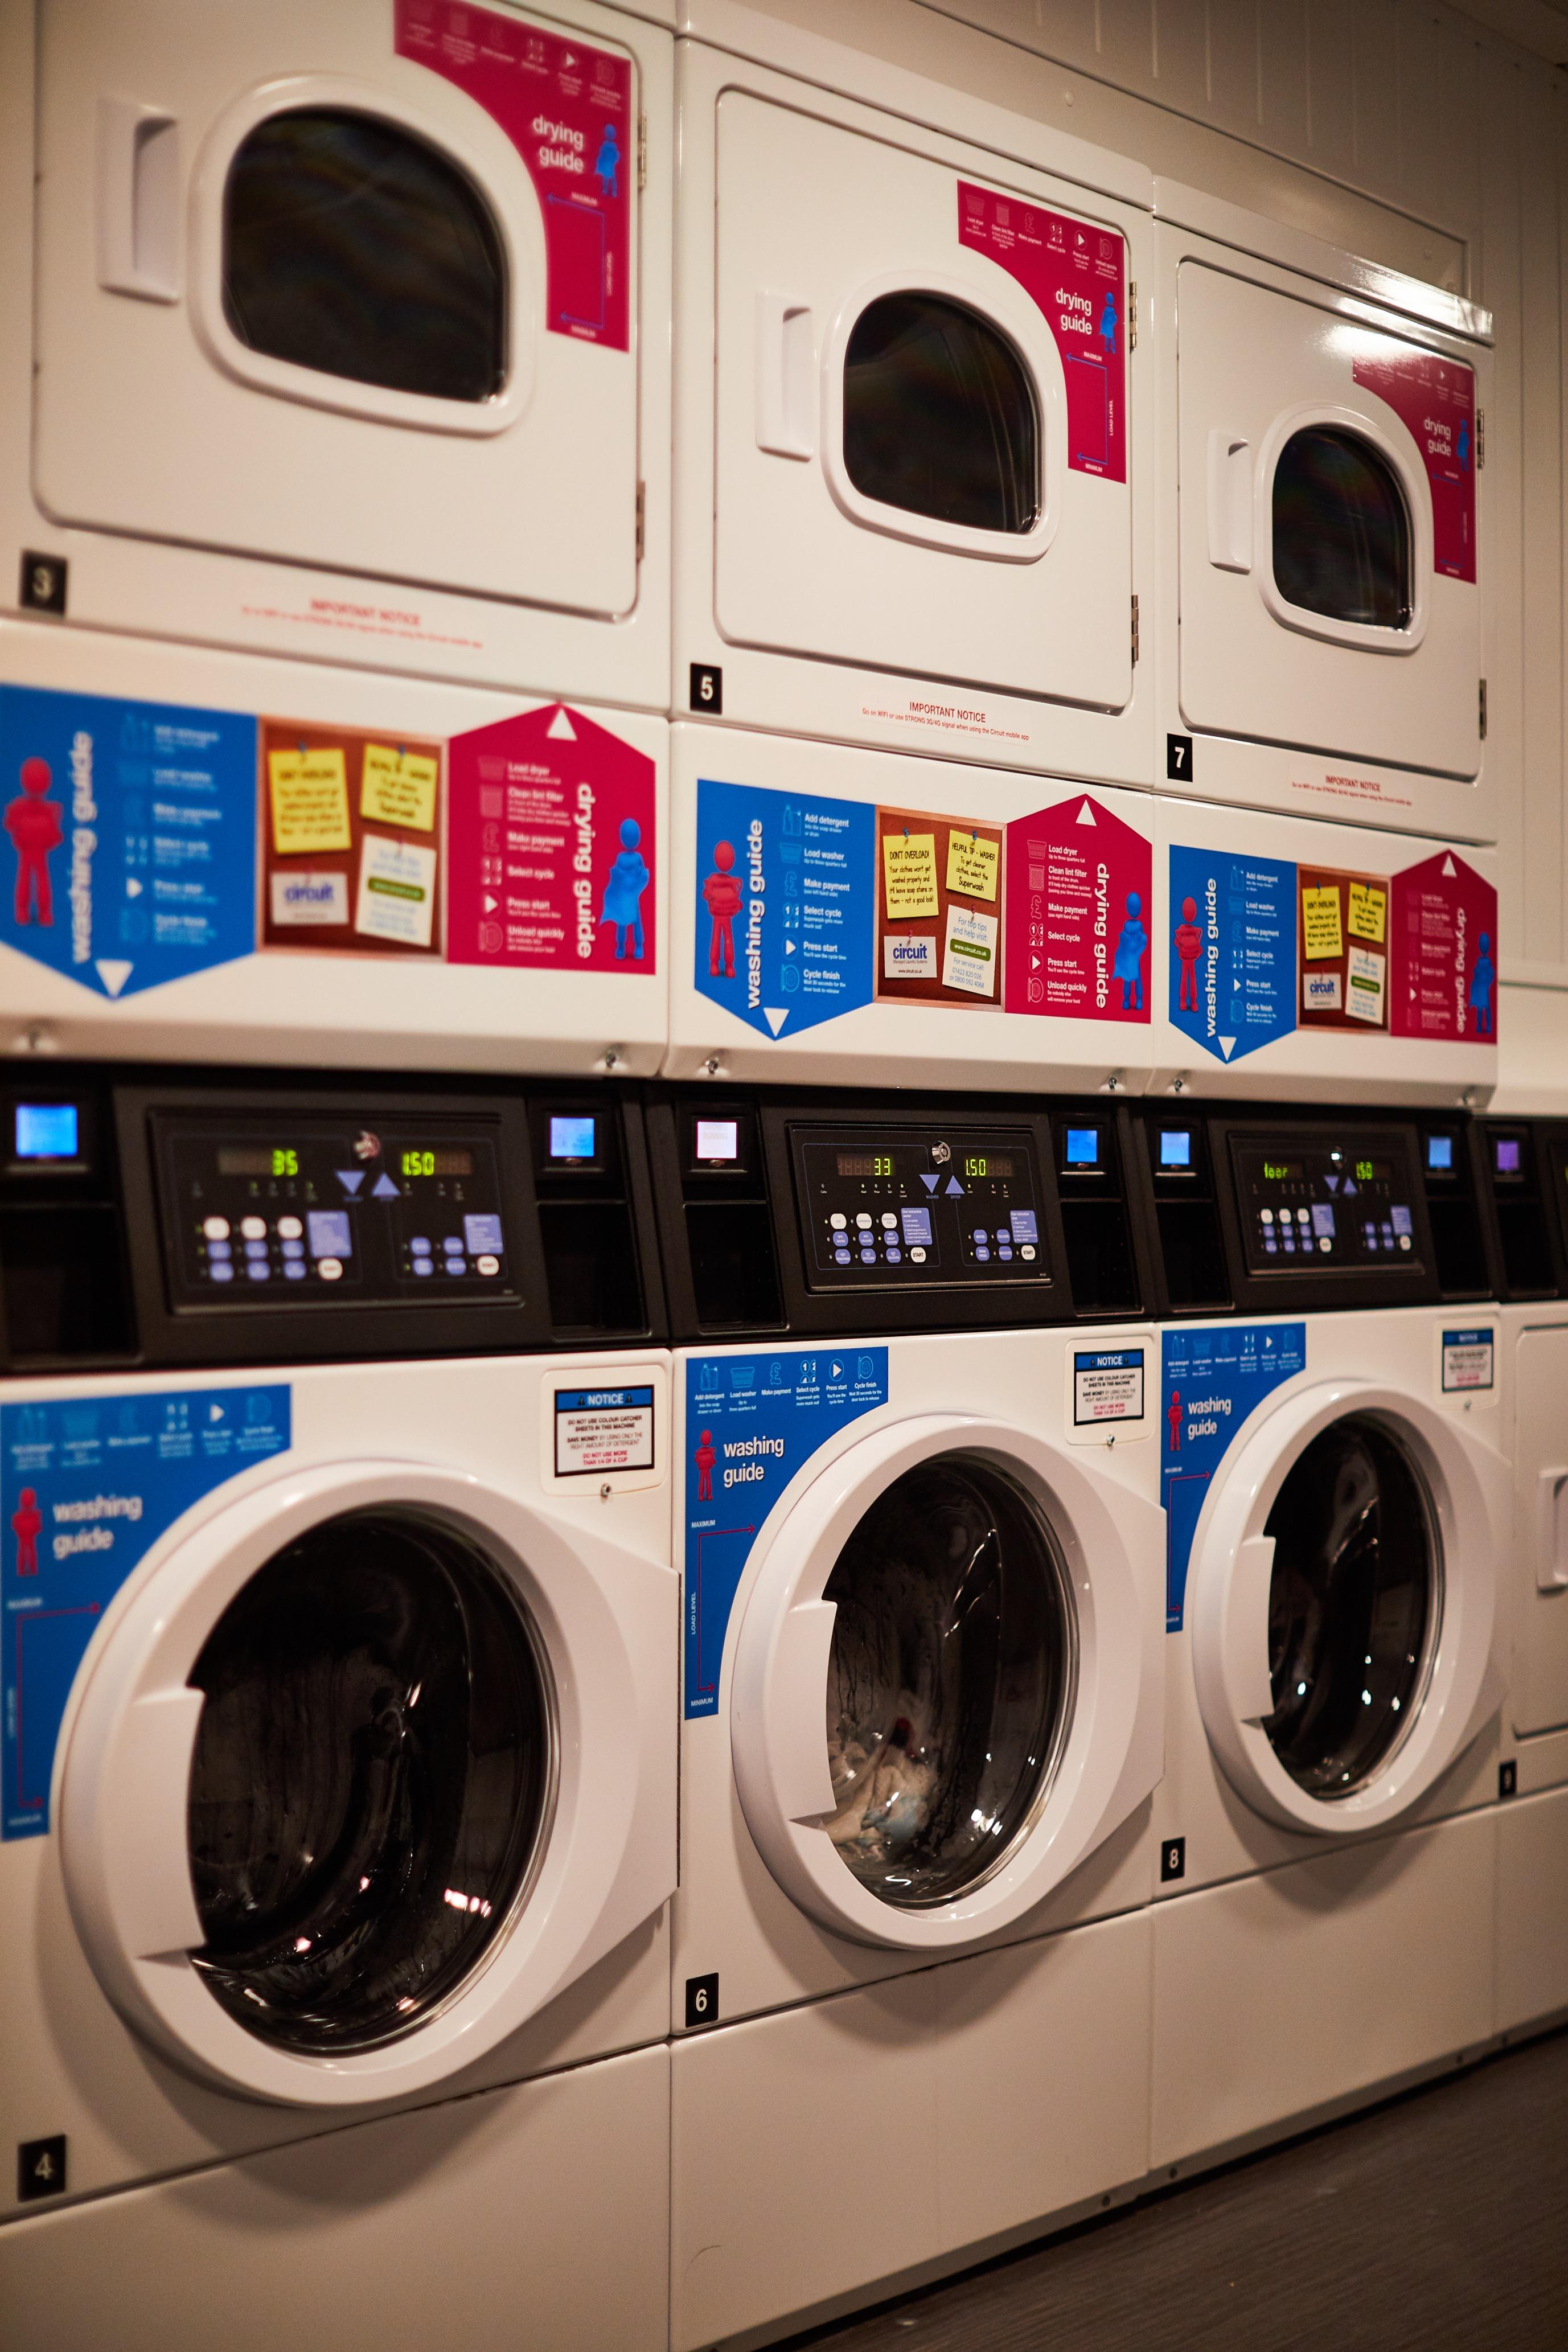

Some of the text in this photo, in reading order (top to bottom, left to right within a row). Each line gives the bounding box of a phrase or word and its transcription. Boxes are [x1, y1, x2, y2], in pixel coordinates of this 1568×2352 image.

[532, 114, 584, 151] drying
[539, 145, 584, 173] guide
[1056, 288, 1091, 317] drying
[1061, 314, 1092, 335] guide
[1084, 351, 1102, 361] MAXIMUM
[1424, 417, 1451, 440] drying
[1427, 438, 1452, 457] guide
[311, 598, 377, 621] IMPORTANT
[380, 609, 421, 627] NOTICE
[701, 676, 712, 700] 5
[905, 715, 925, 724] STRONG
[909, 701, 986, 723] IMPORTANT NOTICE
[1174, 746, 1184, 769] 7
[1325, 775, 1380, 792] IMPORTANT NOTICE
[805, 814, 849, 827] Add detergent
[804, 848, 844, 861] Load washer
[890, 851, 929, 860] DON'T OVERLOAD!
[952, 843, 968, 853] HELPFUL
[979, 850, 996, 861] WASHER
[1049, 844, 1077, 856] Load dryer
[573, 783, 596, 959] drying guide
[956, 866, 970, 876] clothes,
[1048, 865, 1087, 877] Clean lint filter
[804, 878, 850, 892] Make payment
[907, 875, 921, 885] properly
[959, 876, 984, 892] Superwash
[285, 884, 334, 902] circuit
[745, 819, 765, 1009] washing guide
[804, 905, 842, 918] Select cycle
[1048, 903, 1087, 915] Make payment
[953, 926, 988, 942] and help visit:
[968, 920, 976, 929] top
[978, 922, 987, 931] tips
[1048, 931, 1080, 943] Select cycle
[1094, 863, 1110, 1008] drying guide
[803, 941, 838, 953] Press start
[893, 943, 927, 959] circuit
[954, 944, 987, 957] www.circuit.co.uk
[1048, 958, 1063, 967] Press
[1205, 879, 1219, 1037] washing guide
[803, 969, 840, 980] Cycle finish
[952, 967, 964, 976] 01422
[1455, 907, 1467, 1033] drying guide
[1048, 981, 1087, 993] Unload quickly
[1310, 979, 1335, 994] circuit
[272, 1149, 298, 1176] 35
[874, 1157, 890, 1176] 33
[965, 1159, 986, 1176] 1.50
[1097, 1356, 1123, 1366] NOTICE
[588, 1393, 624, 1405] NOTICE
[1188, 1397, 1232, 1415] washing
[1188, 1419, 1217, 1440] guide
[724, 1436, 784, 1458] washing
[724, 1463, 764, 1488] guide
[53, 1494, 143, 1524] washing
[692, 1520, 716, 1528] MAXIMUM
[53, 1527, 114, 1559] guide
[691, 1697, 713, 1706] MINIMUM
[1169, 1849, 1179, 1869] 8
[696, 1989, 707, 2012] 6
[35, 2153, 52, 2179] 4
